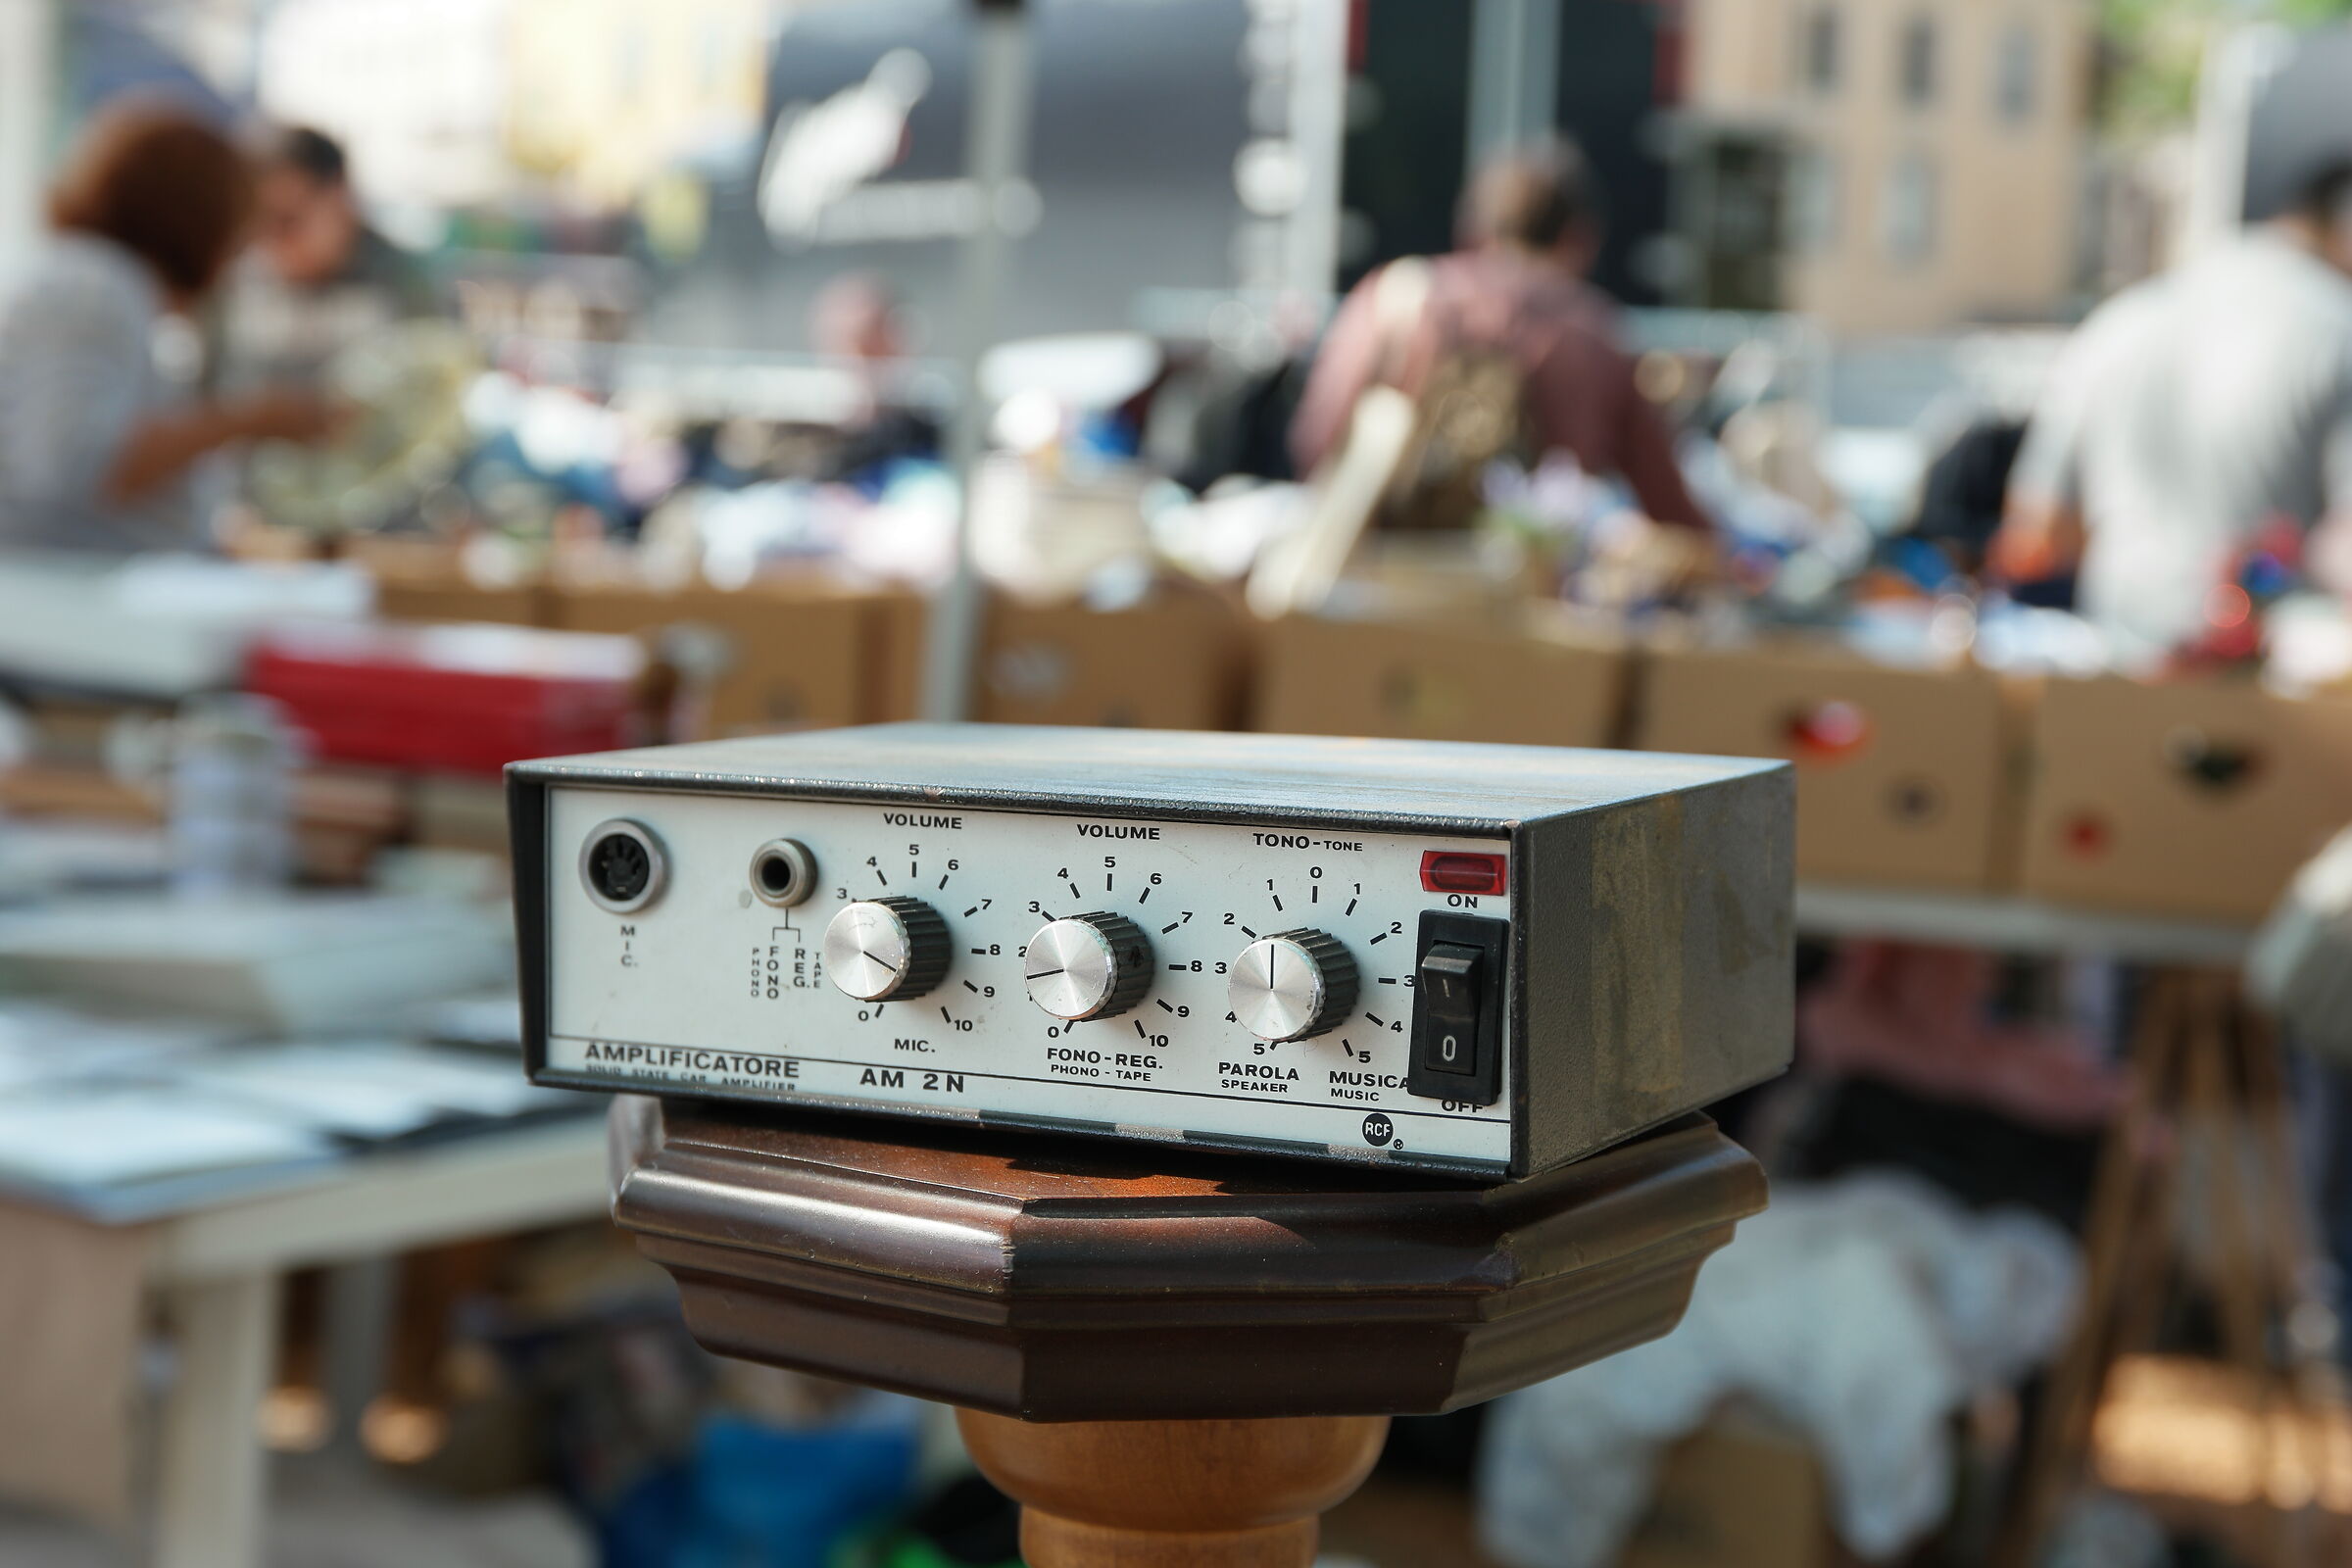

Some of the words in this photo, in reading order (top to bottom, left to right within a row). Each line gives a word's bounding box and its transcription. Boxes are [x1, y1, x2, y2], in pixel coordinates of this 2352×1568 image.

[883, 812, 962, 830] VOLUME
[1077, 824, 1160, 840] VOLUME
[908, 844, 920, 856] 5
[866, 856, 877, 867] 4
[948, 859, 959, 870] 6
[1104, 856, 1116, 868] 5
[1057, 867, 1068, 879] 4
[1150, 873, 1162, 885] 6
[1309, 866, 1322, 879] 0
[1266, 879, 1274, 891] 1
[1353, 883, 1360, 895] 1
[836, 888, 847, 900] 3
[981, 899, 992, 909] 7
[1028, 901, 1040, 913] 3
[1446, 894, 1478, 908] ON
[1181, 911, 1193, 923] 7
[1223, 912, 1235, 925] 2
[1391, 921, 1402, 934] 2
[990, 945, 1001, 956] 8
[1018, 946, 1028, 957] 2
[751, 947, 760, 998] PHONO
[793, 948, 810, 988] REG.
[1191, 960, 1202, 972] 8
[1214, 961, 1227, 974] 3
[766, 946, 779, 1000] FONO
[1403, 974, 1415, 987] 3
[983, 986, 995, 998] 9
[858, 1010, 869, 1021] 0
[1177, 1005, 1190, 1017] 9
[1225, 1010, 1238, 1023] 4
[955, 1020, 973, 1031] 10
[1048, 1026, 1059, 1038] 0
[1391, 1020, 1402, 1033] 4
[894, 1038, 936, 1053] MIC.
[1149, 1035, 1169, 1048] 10
[1443, 1035, 1456, 1061] 0
[1253, 1043, 1265, 1055] 5
[585, 1043, 800, 1078] AMPLIFICATORE
[1358, 1051, 1371, 1063] 5
[859, 1068, 905, 1088] AM
[1218, 1062, 1299, 1081] PAROLA
[721, 1077, 795, 1091] AMPLIFIER
[1221, 1079, 1289, 1093] SPEAKER
[1329, 1070, 1409, 1090] MUSICA
[1331, 1088, 1380, 1102] MUSIC
[1365, 1121, 1391, 1137] RCF
